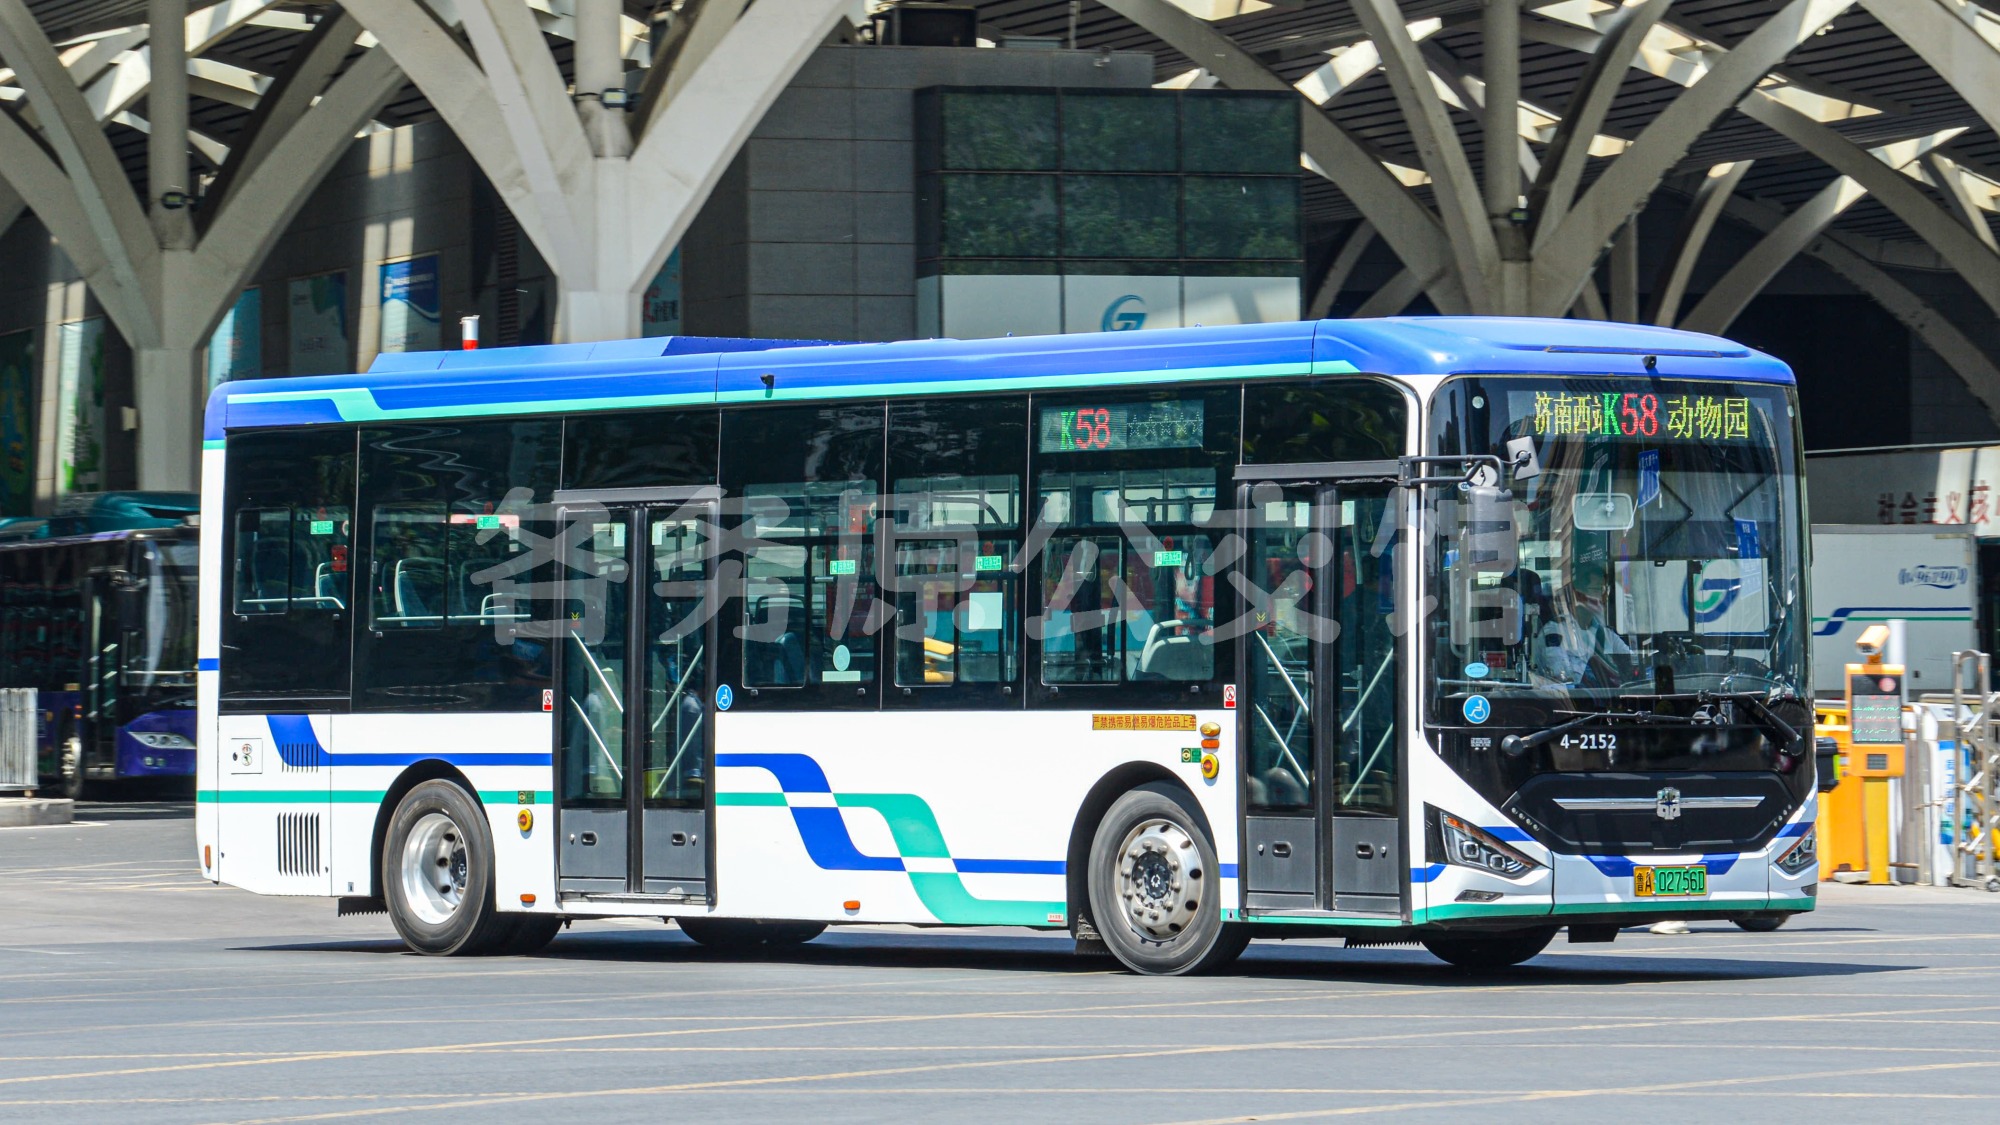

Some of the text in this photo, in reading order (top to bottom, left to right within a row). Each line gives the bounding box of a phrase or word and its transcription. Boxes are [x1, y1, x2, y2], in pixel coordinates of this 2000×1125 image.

[1060, 408, 1112, 449] K58
[1602, 392, 1660, 437] K58
[1667, 394, 1750, 440] 动物园
[1877, 480, 2000, 525] 社会主义核
[1559, 733, 1617, 750] 4-2152
